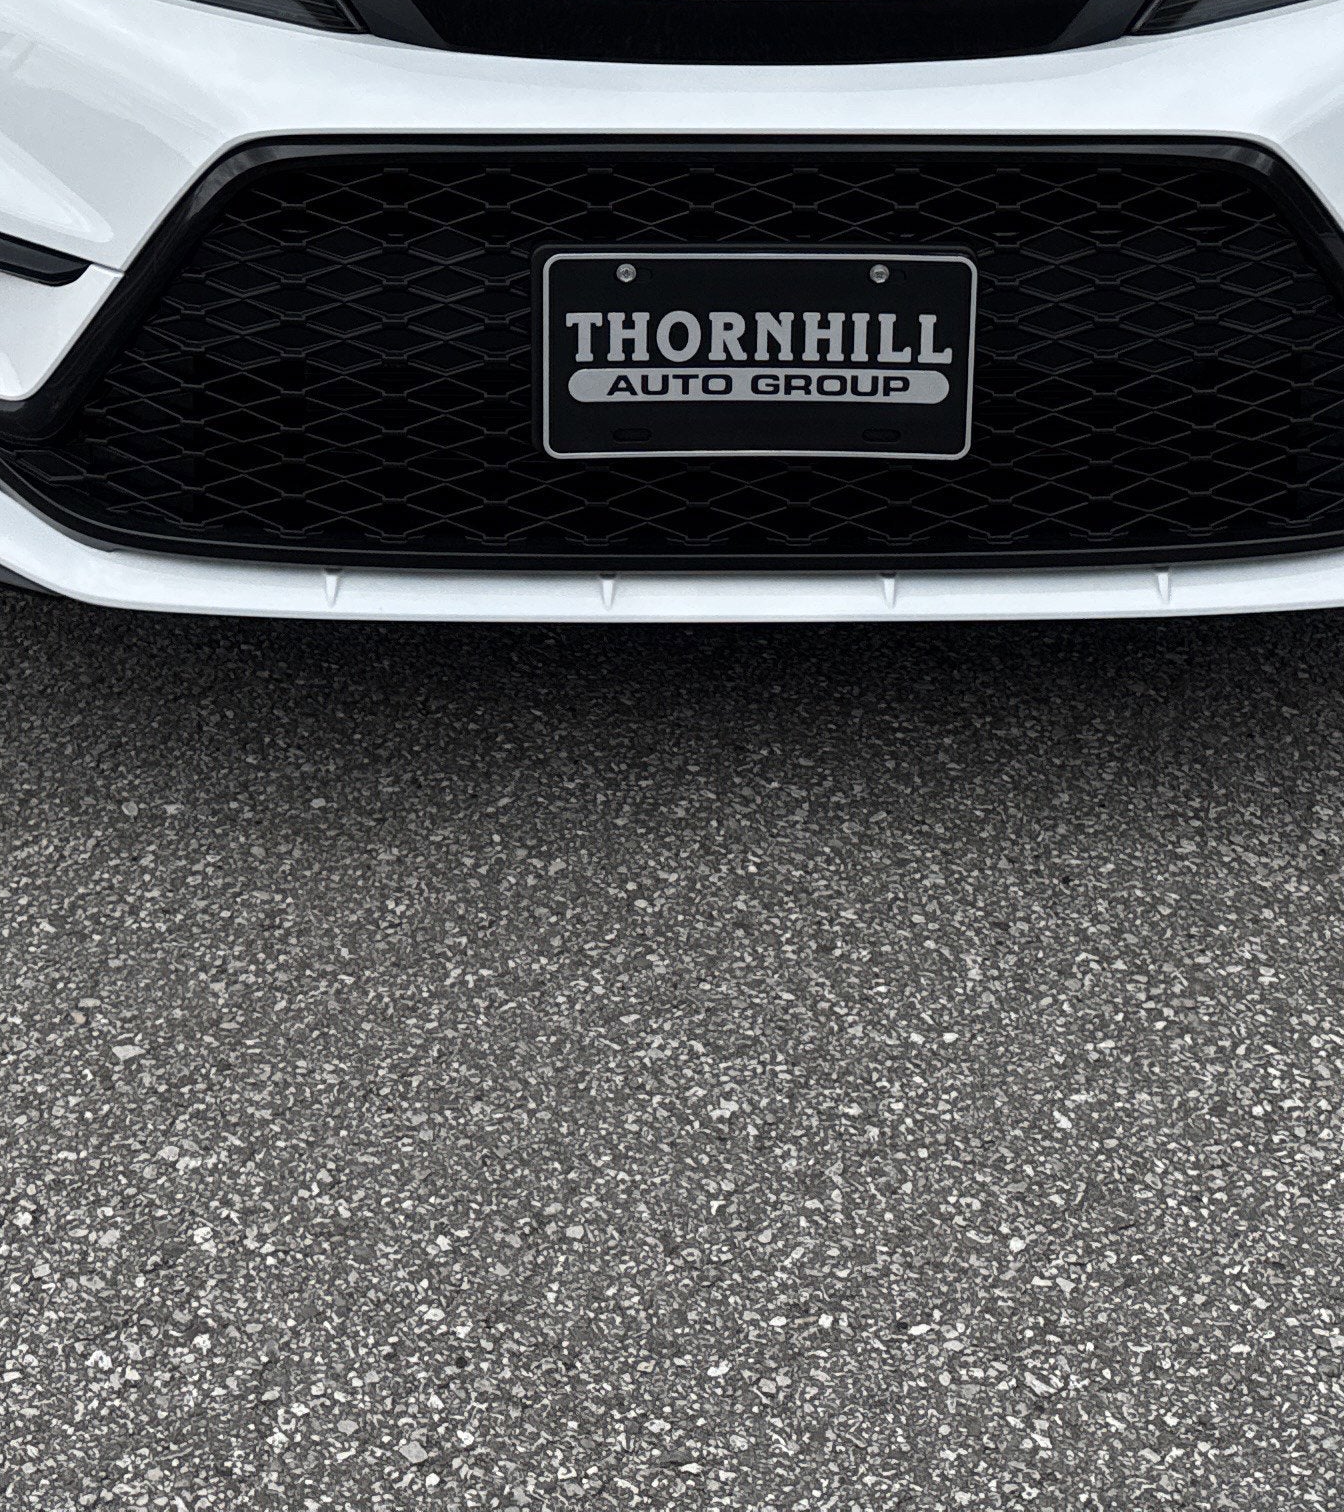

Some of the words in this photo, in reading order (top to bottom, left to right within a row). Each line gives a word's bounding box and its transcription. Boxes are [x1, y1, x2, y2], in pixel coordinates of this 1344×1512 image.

[566, 310, 953, 364] THORNHILL
[607, 374, 733, 396] AUTO
[751, 374, 911, 397] GROUP
